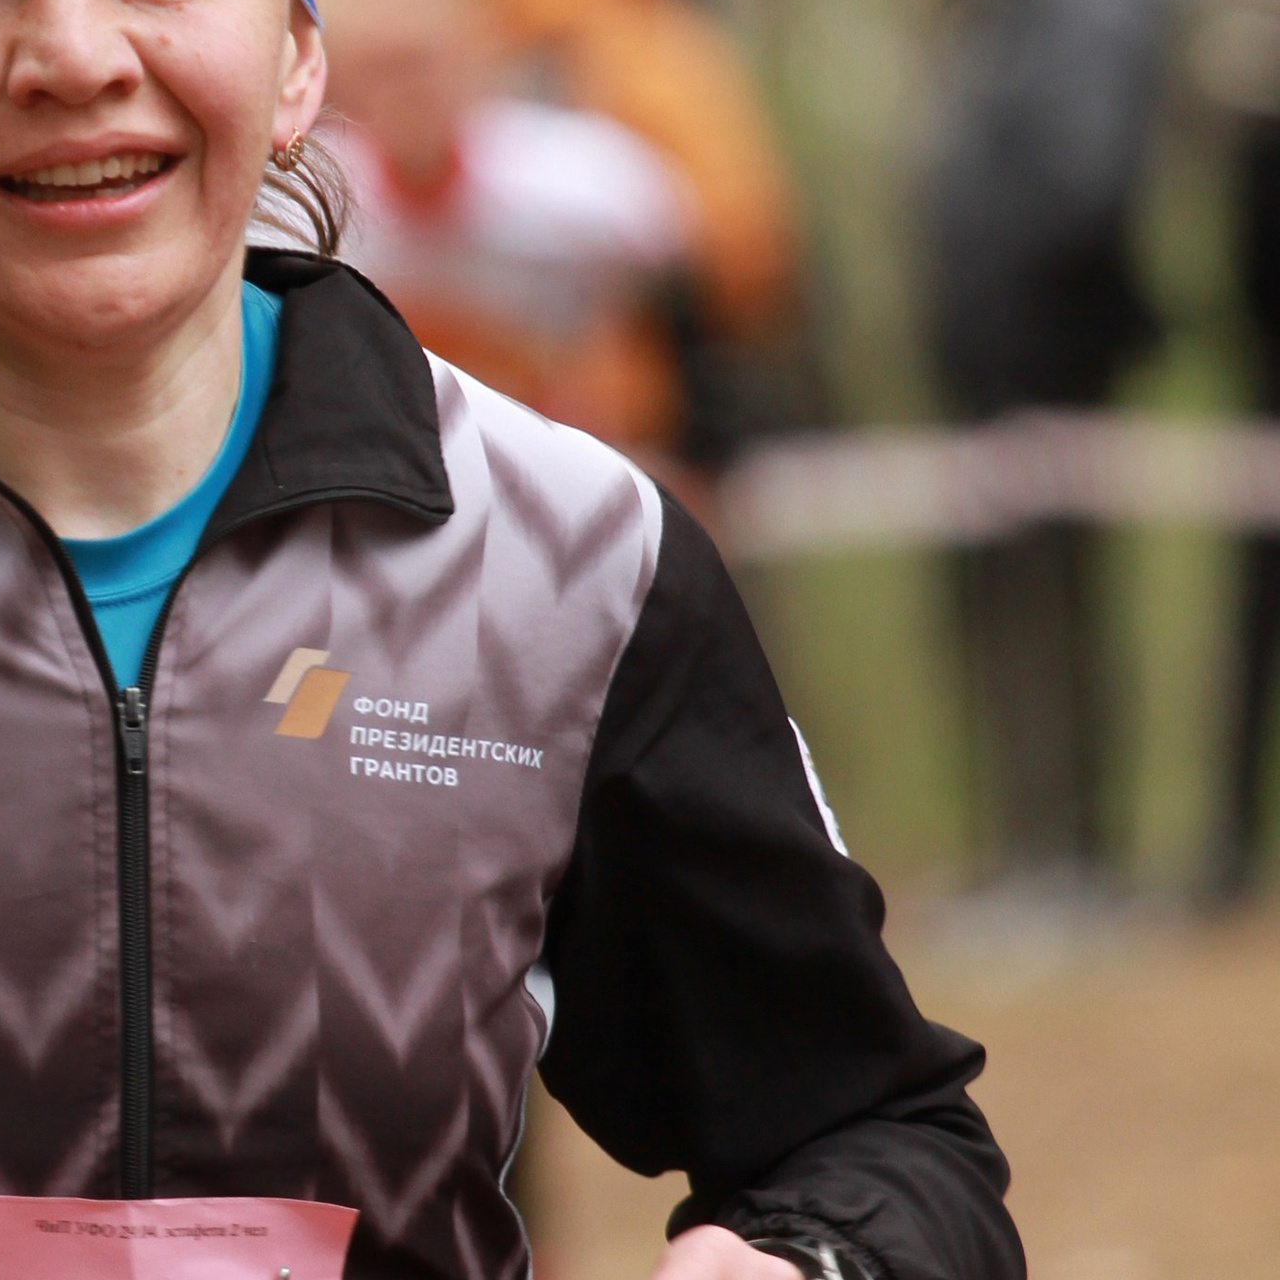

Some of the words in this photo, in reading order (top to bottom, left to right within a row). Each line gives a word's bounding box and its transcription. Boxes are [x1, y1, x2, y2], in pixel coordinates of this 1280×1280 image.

[353, 695, 429, 725] ФОНД
[349, 725, 544, 770] ПРЕЗИДЕНТСКИХ
[349, 756, 459, 787] ГРАНТОВ
